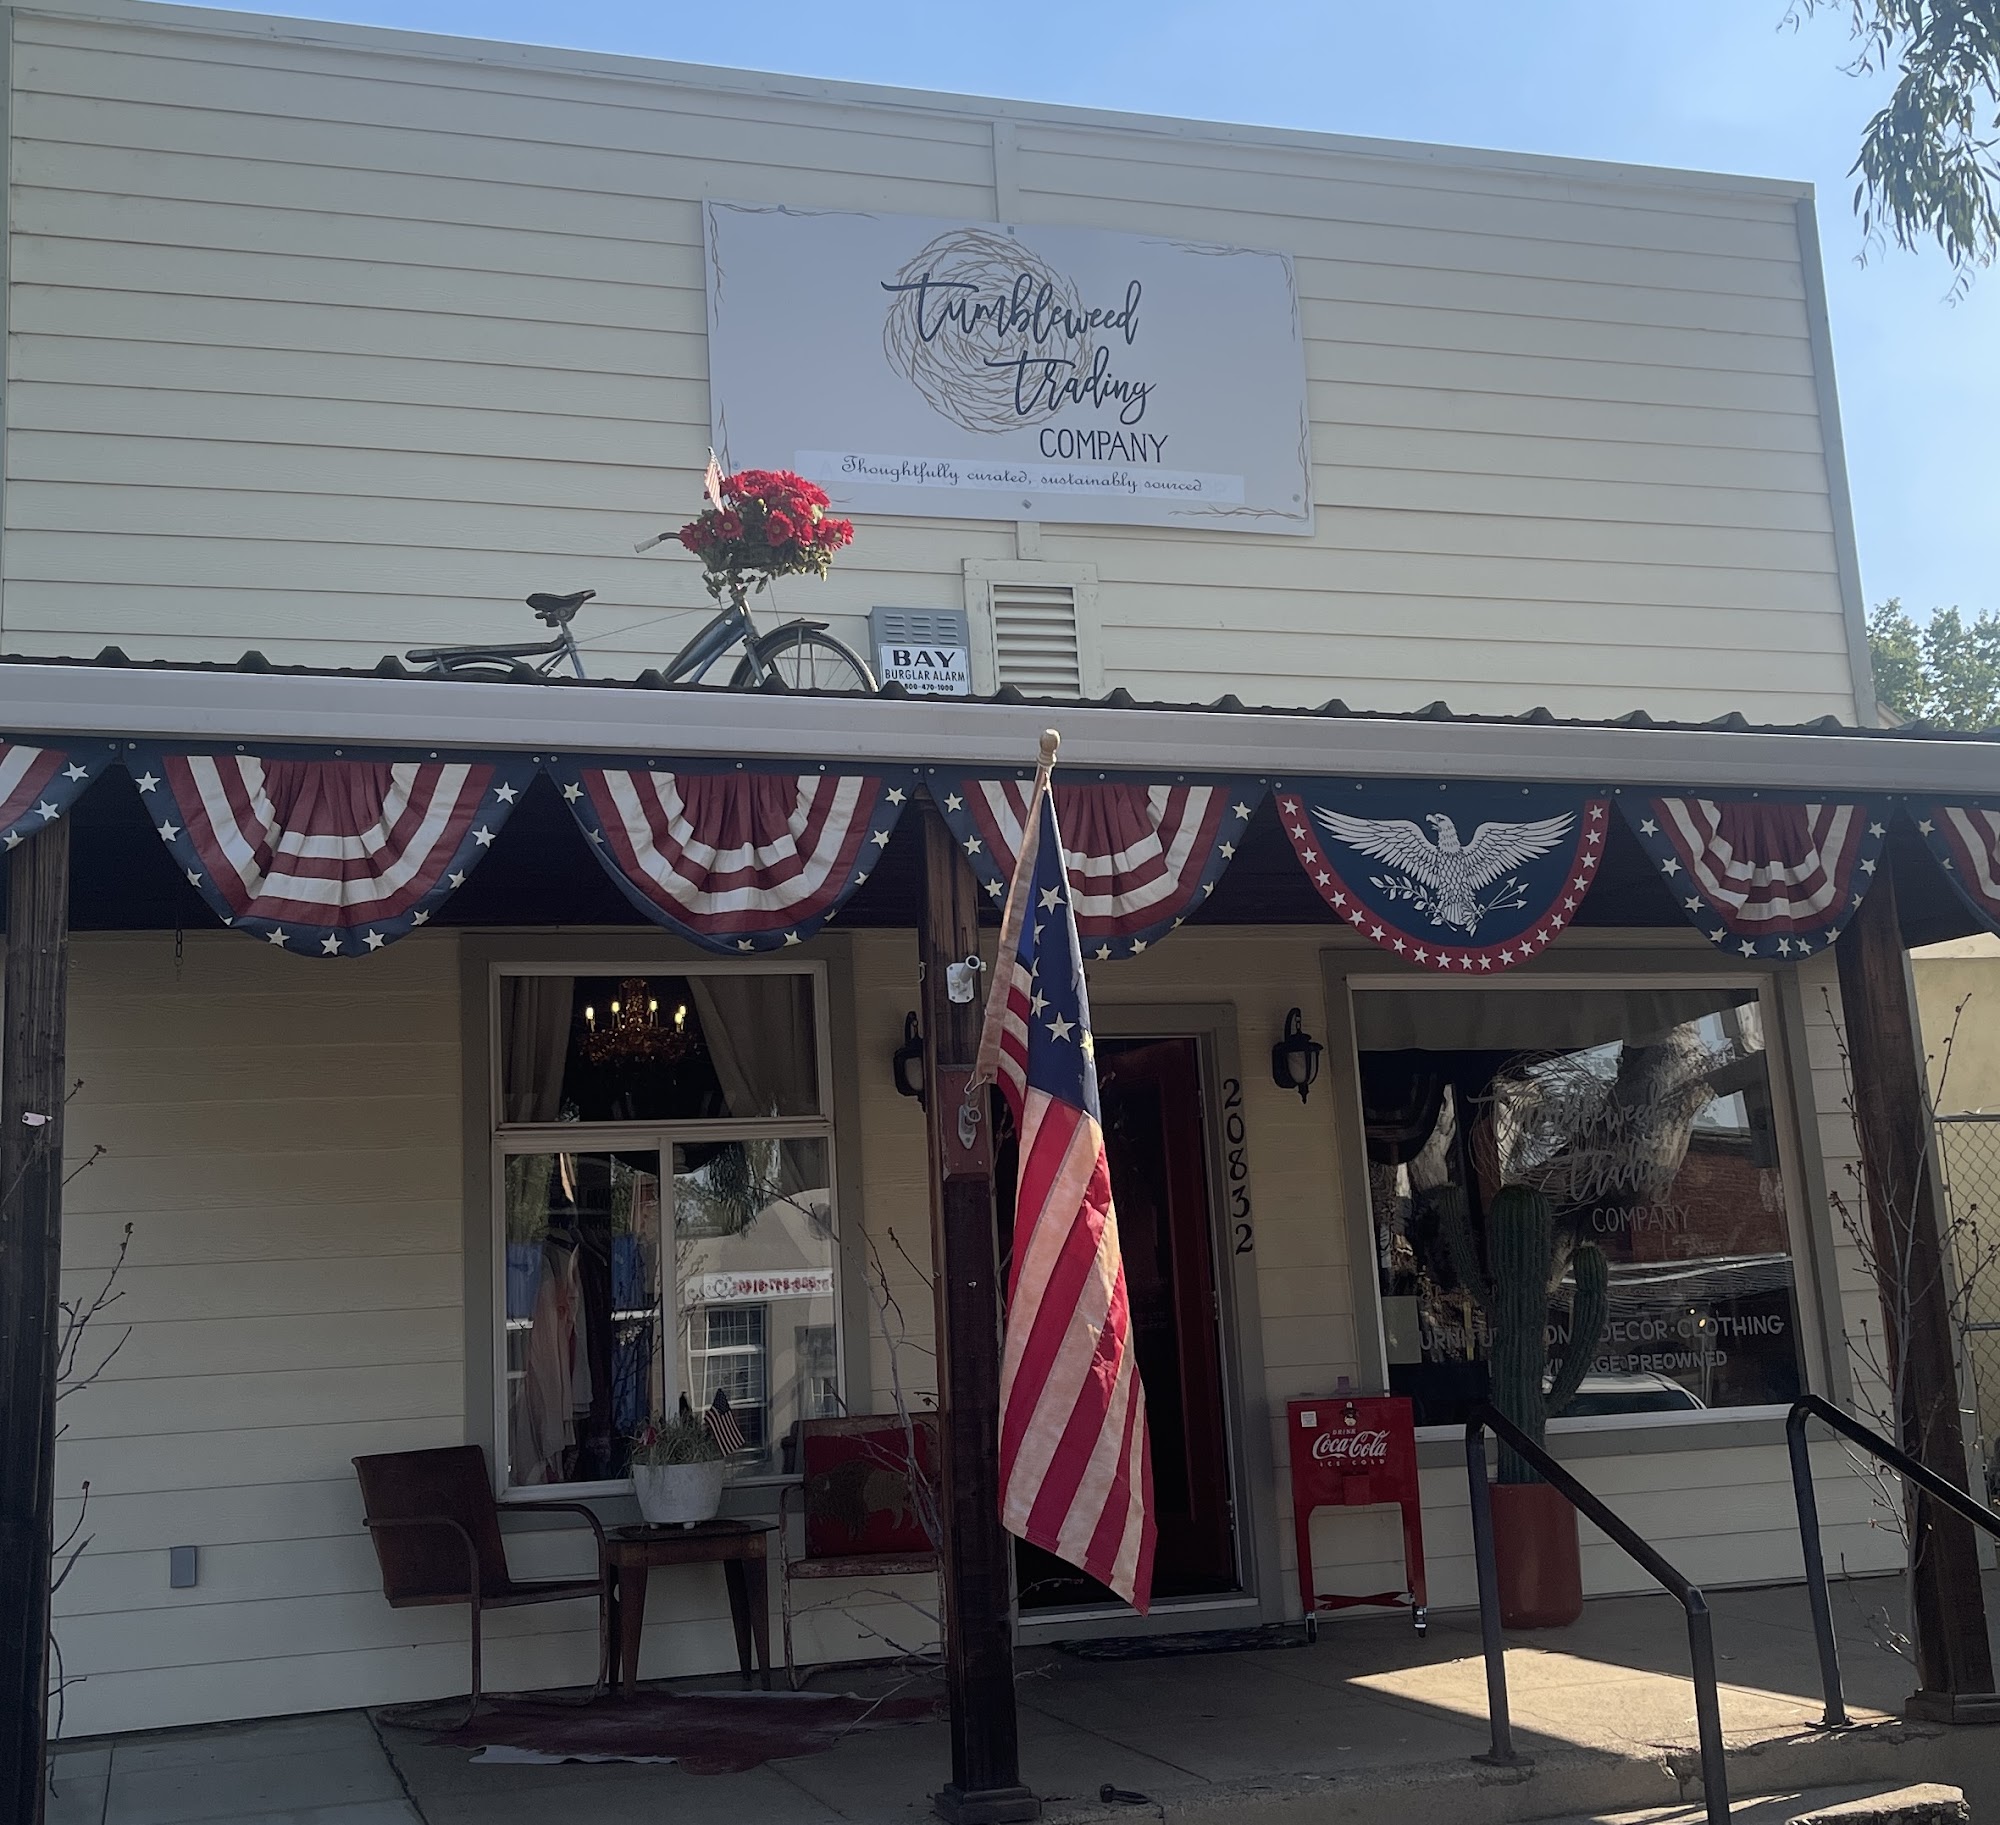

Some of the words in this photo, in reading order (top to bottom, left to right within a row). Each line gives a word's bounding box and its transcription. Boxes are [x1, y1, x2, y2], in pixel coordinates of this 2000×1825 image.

[1039, 428, 1169, 463] COMPANY
[841, 455, 960, 485] Thoughtfully
[967, 470, 1032, 485] curated,
[1041, 473, 1138, 493] sustainably
[1144, 478, 1202, 492] sourced
[893, 649, 955, 668] BAY
[885, 668, 930, 681] BURGLAR
[933, 670, 965, 682] ALARM
[1223, 1078, 1253, 1255] 20832
[1592, 1203, 1692, 1233] COMPANY
